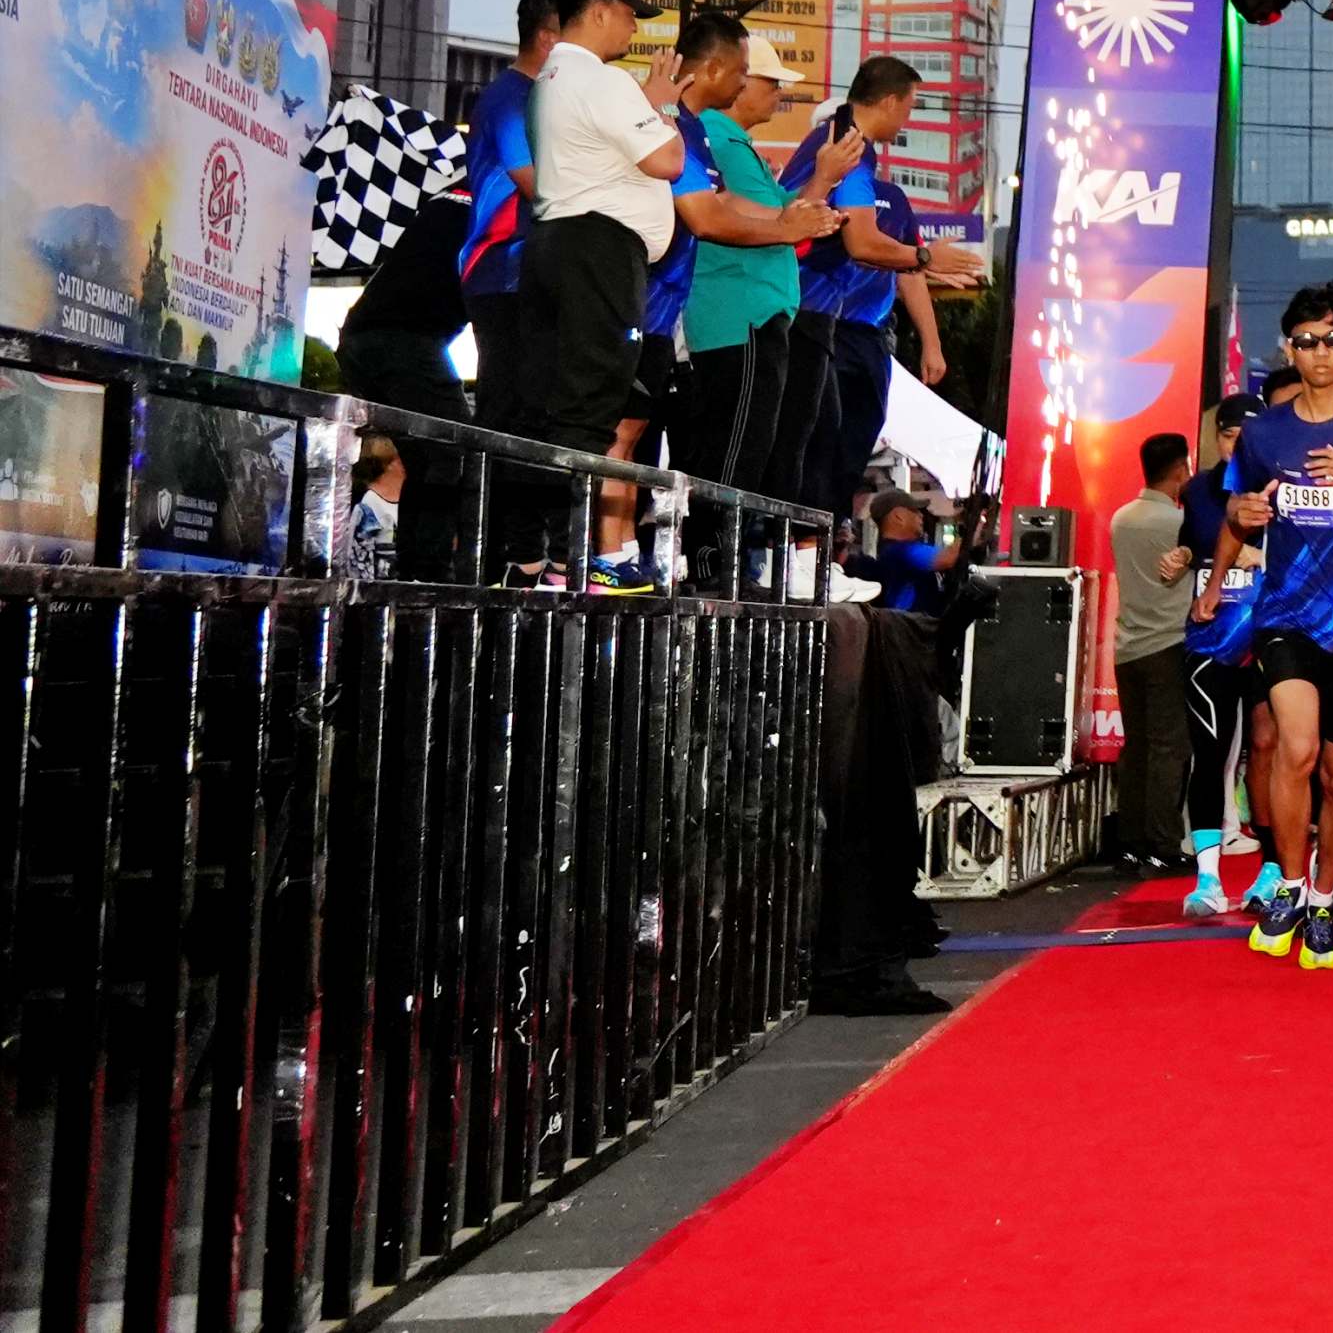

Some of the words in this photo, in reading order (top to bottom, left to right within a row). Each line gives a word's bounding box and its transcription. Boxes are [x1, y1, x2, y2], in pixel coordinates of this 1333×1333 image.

[206, 65, 259, 111] DIRGAHAYU
[168, 72, 208, 112] TENTARA
[208, 95, 248, 139] NASIONAL
[249, 121, 289, 160] INDONESIA
[1055, 170, 1181, 226] KAI
[208, 229, 232, 252] PRIMA
[919, 225, 966, 239] NLINE
[57, 272, 83, 304] SATU
[85, 279, 134, 318] SEMANGAT
[62, 305, 88, 335] SATU
[89, 314, 125, 345] TUJUAN
[1285, 486, 1330, 507] 51968
